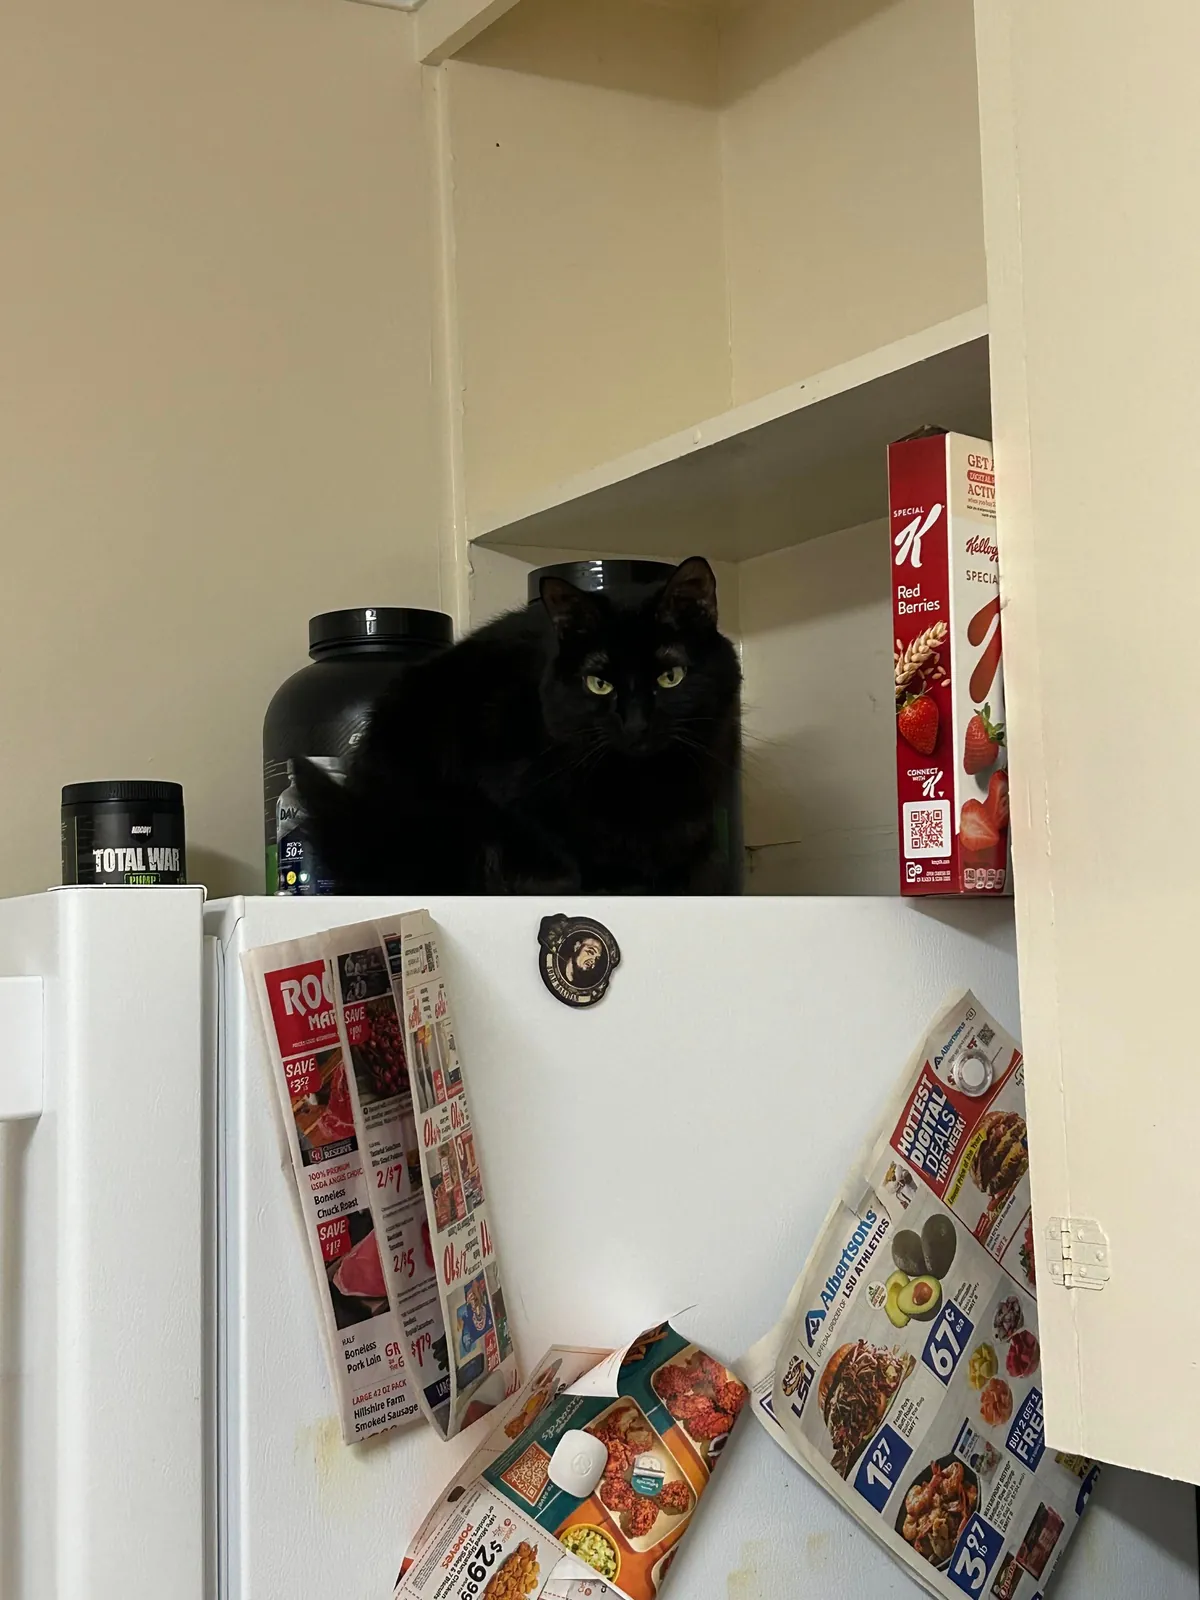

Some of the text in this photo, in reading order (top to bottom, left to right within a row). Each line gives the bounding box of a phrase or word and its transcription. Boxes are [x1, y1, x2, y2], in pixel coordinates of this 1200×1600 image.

[967, 453, 989, 470] GET
[893, 506, 924, 518] SPECIAL
[966, 534, 1000, 563] Kellog
[897, 584, 921, 599] Red
[898, 598, 940, 615] Berries
[907, 767, 938, 777] CONNECT
[280, 808, 298, 820] DAY
[92, 847, 180, 873] TOTAL WAR
[285, 847, 303, 857] 50+
[344, 1006, 364, 1023] SAVE
[940, 1021, 966, 1056] Albertsons
[286, 1057, 316, 1077] SAVE
[898, 1073, 934, 1156] HOTTEST
[909, 1091, 947, 1167] DIGITAL
[324, 1143, 352, 1158] RESERVE
[925, 1108, 957, 1173] DEALS
[935, 1116, 967, 1184] THIS WEEK!
[308, 1170, 325, 1181] 100%
[947, 1131, 983, 1203] Lowest Price of the Year!
[310, 1179, 327, 1191] USDA
[313, 1188, 345, 1205] Boneless
[317, 1197, 358, 1218] Chuck Roast
[319, 1220, 346, 1240] SAVE
[818, 1208, 879, 1310] Albertsons
[815, 1330, 831, 1357] OFFICIAL
[826, 1306, 843, 1332] GROCER
[839, 1298, 847, 1308] OF
[843, 1274, 859, 1298] LSU
[856, 1217, 890, 1276] ATHLETICS
[955, 1318, 964, 1332] ea
[341, 1335, 355, 1346] HALF
[344, 1340, 376, 1360] Boneless
[347, 1354, 381, 1373] Pork Loin
[352, 1378, 406, 1405] LARGE 42 OZ PACK
[792, 1361, 817, 1418] LSU
[354, 1393, 405, 1419] Hillshire Farm
[892, 1396, 910, 1425] Fresh Pork
[915, 1395, 924, 1407] Bag
[355, 1402, 418, 1432] Smoked Sausage
[897, 1401, 914, 1429] Butt Roast
[1009, 1393, 1039, 1448] BUY 2 GET 1
[904, 1419, 916, 1437] LIMIT
[883, 1461, 893, 1475] lb
[536, 1491, 548, 1510] save!
[983, 1481, 1002, 1516] WATERFRONT
[987, 1499, 1000, 1521] Medium
[1003, 1469, 1015, 1488] Shrimp
[1001, 1514, 1012, 1532] LIMIT
[462, 1542, 471, 1550] Lg
[473, 1526, 488, 1546] Mixed
[453, 1550, 466, 1567] Sides
[456, 1545, 477, 1575] Signature
[955, 1521, 988, 1589] 397
[978, 1544, 988, 1559] lb
[433, 1575, 453, 1600] Biscuits
[441, 1574, 459, 1599] Chicken
